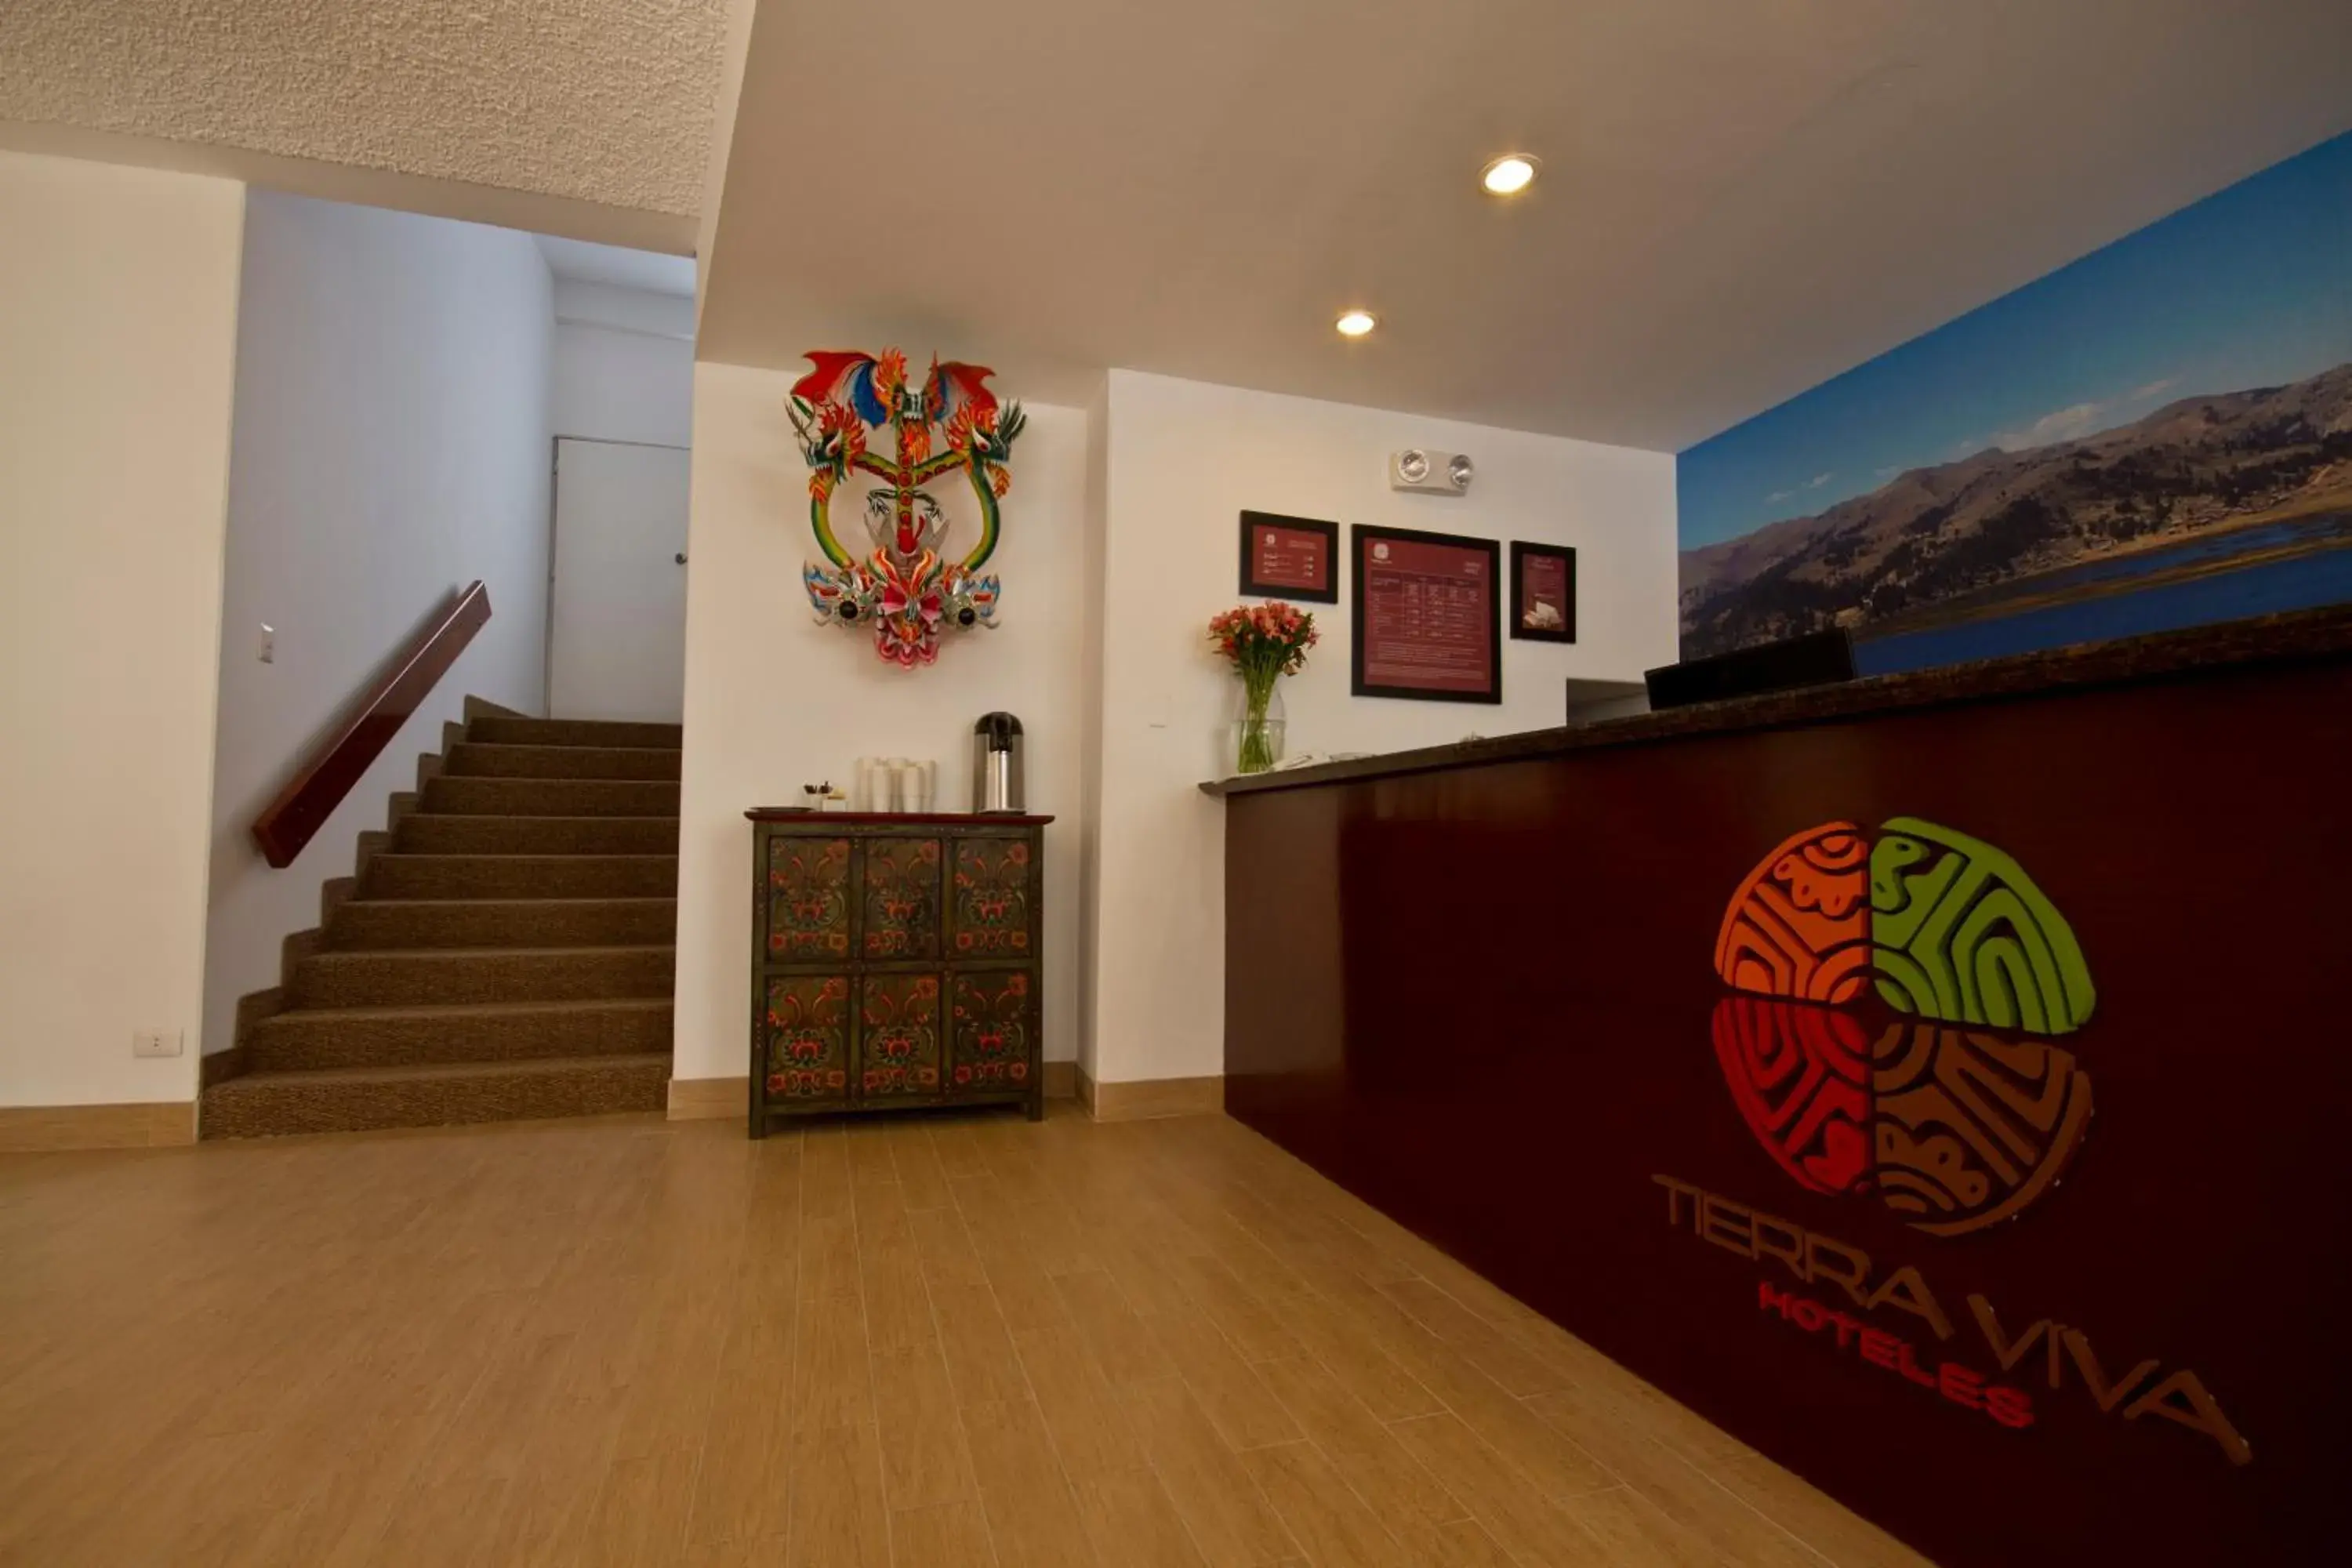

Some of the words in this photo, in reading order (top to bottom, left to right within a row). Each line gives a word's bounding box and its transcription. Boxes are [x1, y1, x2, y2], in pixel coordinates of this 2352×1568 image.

[1651, 1174, 1955, 1341] TIERRA
[1966, 1294, 2252, 1465] VIVA
[1759, 1281, 2034, 1429] HOTELES
